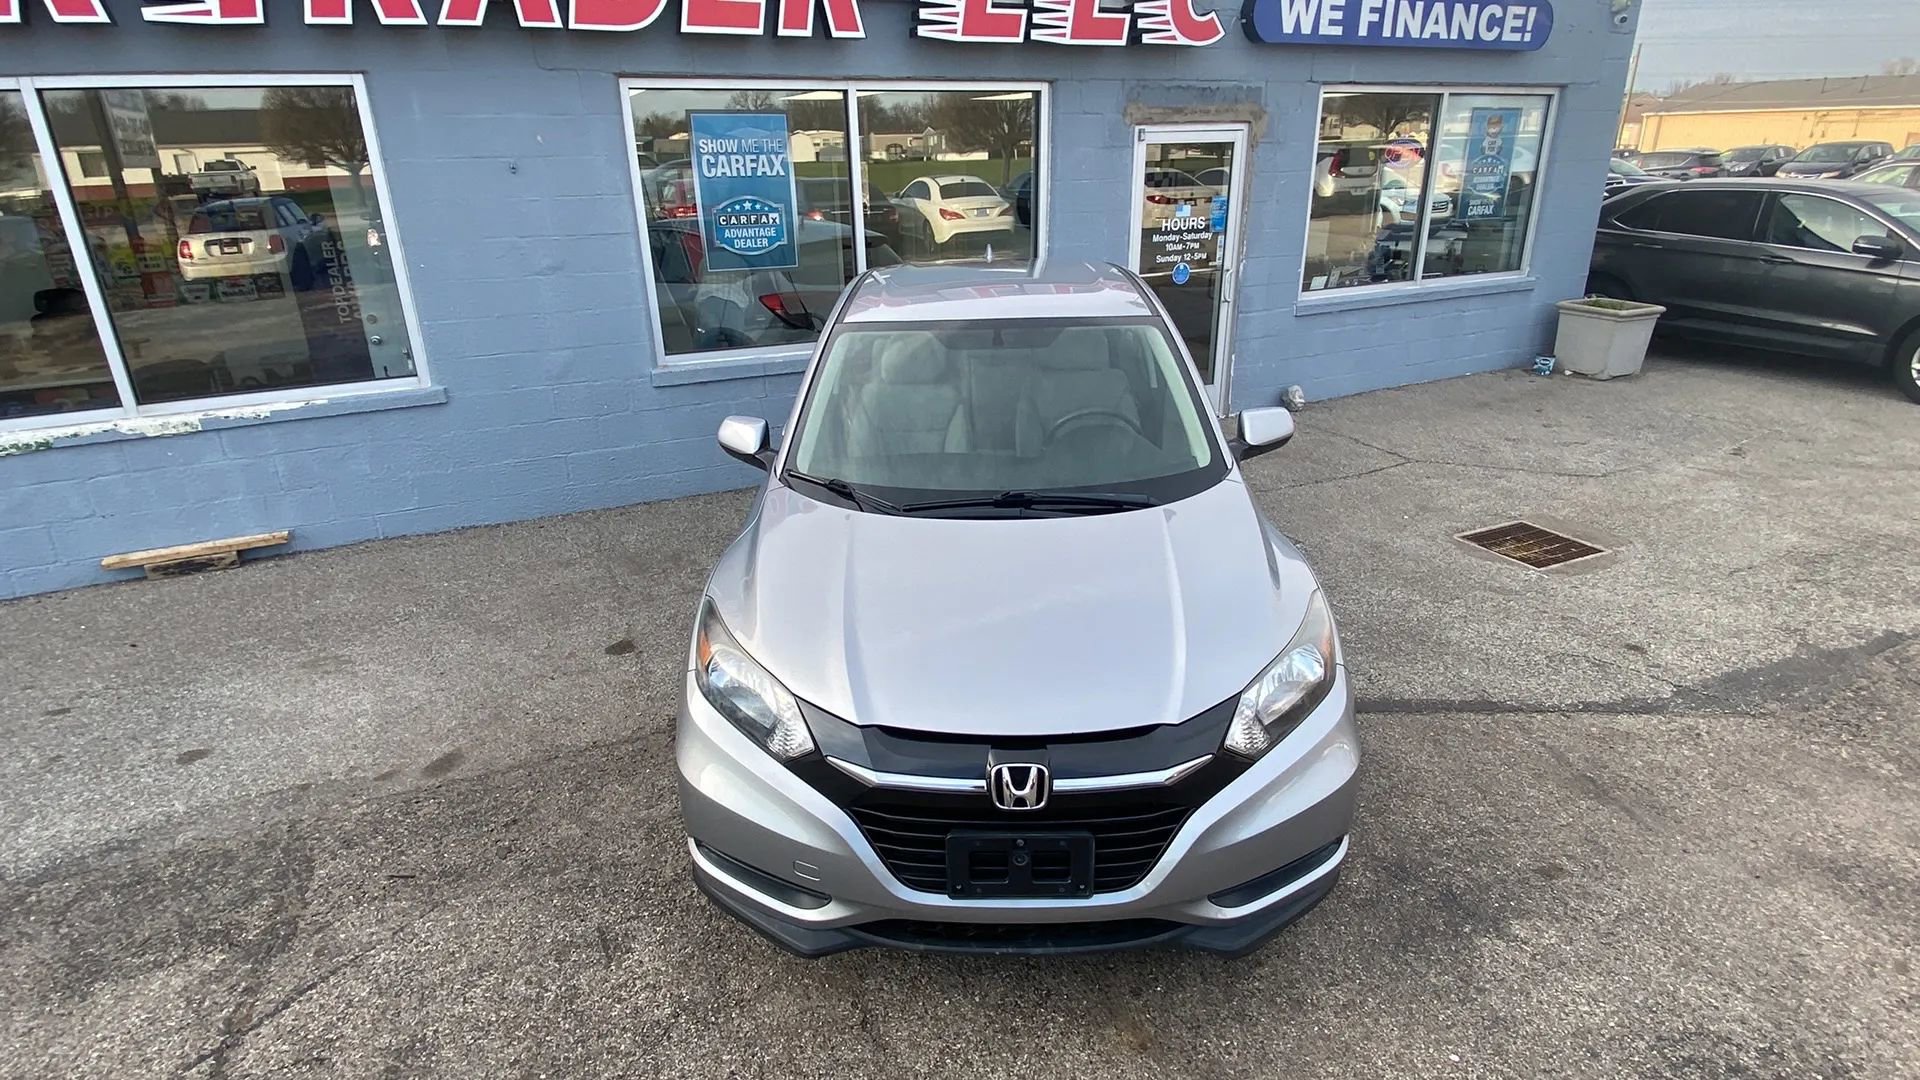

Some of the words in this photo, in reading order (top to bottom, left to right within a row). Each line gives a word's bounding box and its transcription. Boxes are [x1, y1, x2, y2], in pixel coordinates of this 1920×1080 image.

[1280, 0, 1343, 35] WE
[1358, 0, 1537, 42] FINANCE!
[700, 138, 738, 153] SHOW
[742, 139, 760, 152] ME
[763, 138, 784, 152] THE
[702, 154, 786, 177] CARFAX
[1468, 205, 1494, 215] CARFAX
[718, 213, 780, 225] CARFAX
[1162, 216, 1206, 231] HOURS
[724, 227, 777, 238] ADVANTAGE
[1152, 232, 1213, 242] Monday-Saturday
[734, 238, 769, 249] DEALER
[1165, 242, 1200, 251] 10AM-7PM
[1156, 254, 1182, 263] Sunday
[1183, 252, 1207, 260] 12-5PM
